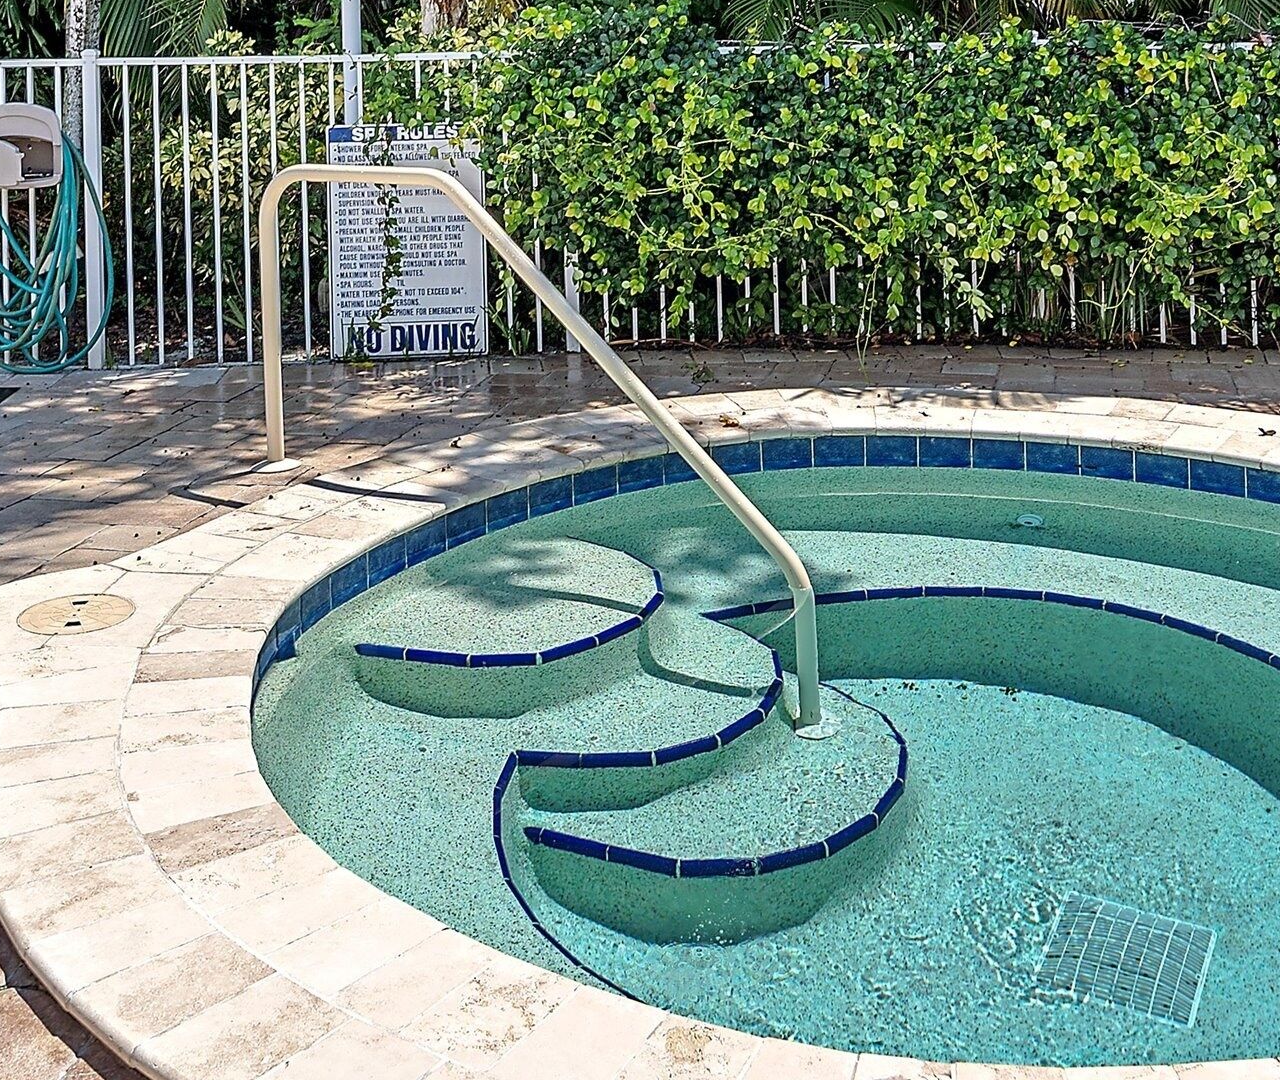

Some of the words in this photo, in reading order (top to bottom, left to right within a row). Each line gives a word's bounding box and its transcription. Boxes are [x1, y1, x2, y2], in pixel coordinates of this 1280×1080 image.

[397, 125, 458, 140] RULES
[389, 144, 414, 152] NTERING
[338, 155, 345, 163] NO
[454, 151, 475, 159] FENCED
[338, 191, 365, 199] CHILDREN
[391, 207, 402, 215] SPA
[348, 218, 359, 226] NOT
[355, 236, 376, 244] HEALTH
[444, 233, 461, 241] USING
[429, 242, 448, 250] DRUGS
[360, 253, 390, 261] DROWSIN
[339, 262, 357, 270] POOLS
[402, 260, 437, 268] CONSULTING
[339, 271, 368, 279] MAXIMUM
[399, 269, 425, 277] INUTES.
[418, 288, 426, 296] TO
[428, 307, 462, 315] EMERGENCY
[464, 306, 475, 314] USE
[390, 322, 476, 352] DIVING
